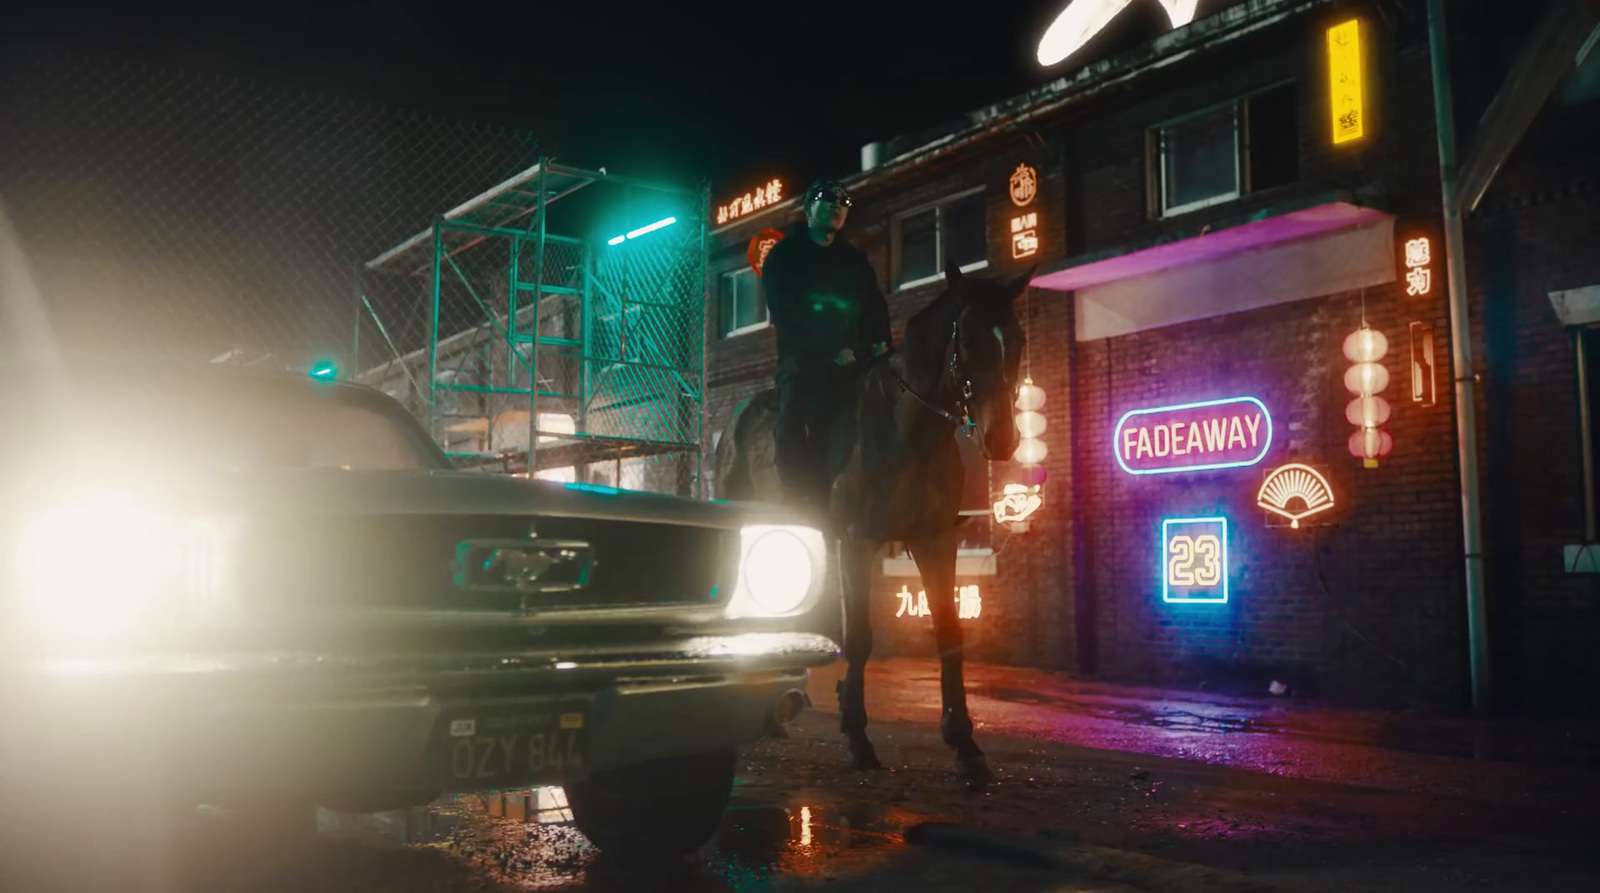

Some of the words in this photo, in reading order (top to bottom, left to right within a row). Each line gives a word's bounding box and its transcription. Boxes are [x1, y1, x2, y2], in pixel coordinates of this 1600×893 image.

[1123, 413, 1262, 460] FADEAWAY
[1169, 534, 1221, 586] 23
[452, 733, 518, 779] OZY
[529, 730, 583, 772] 844
